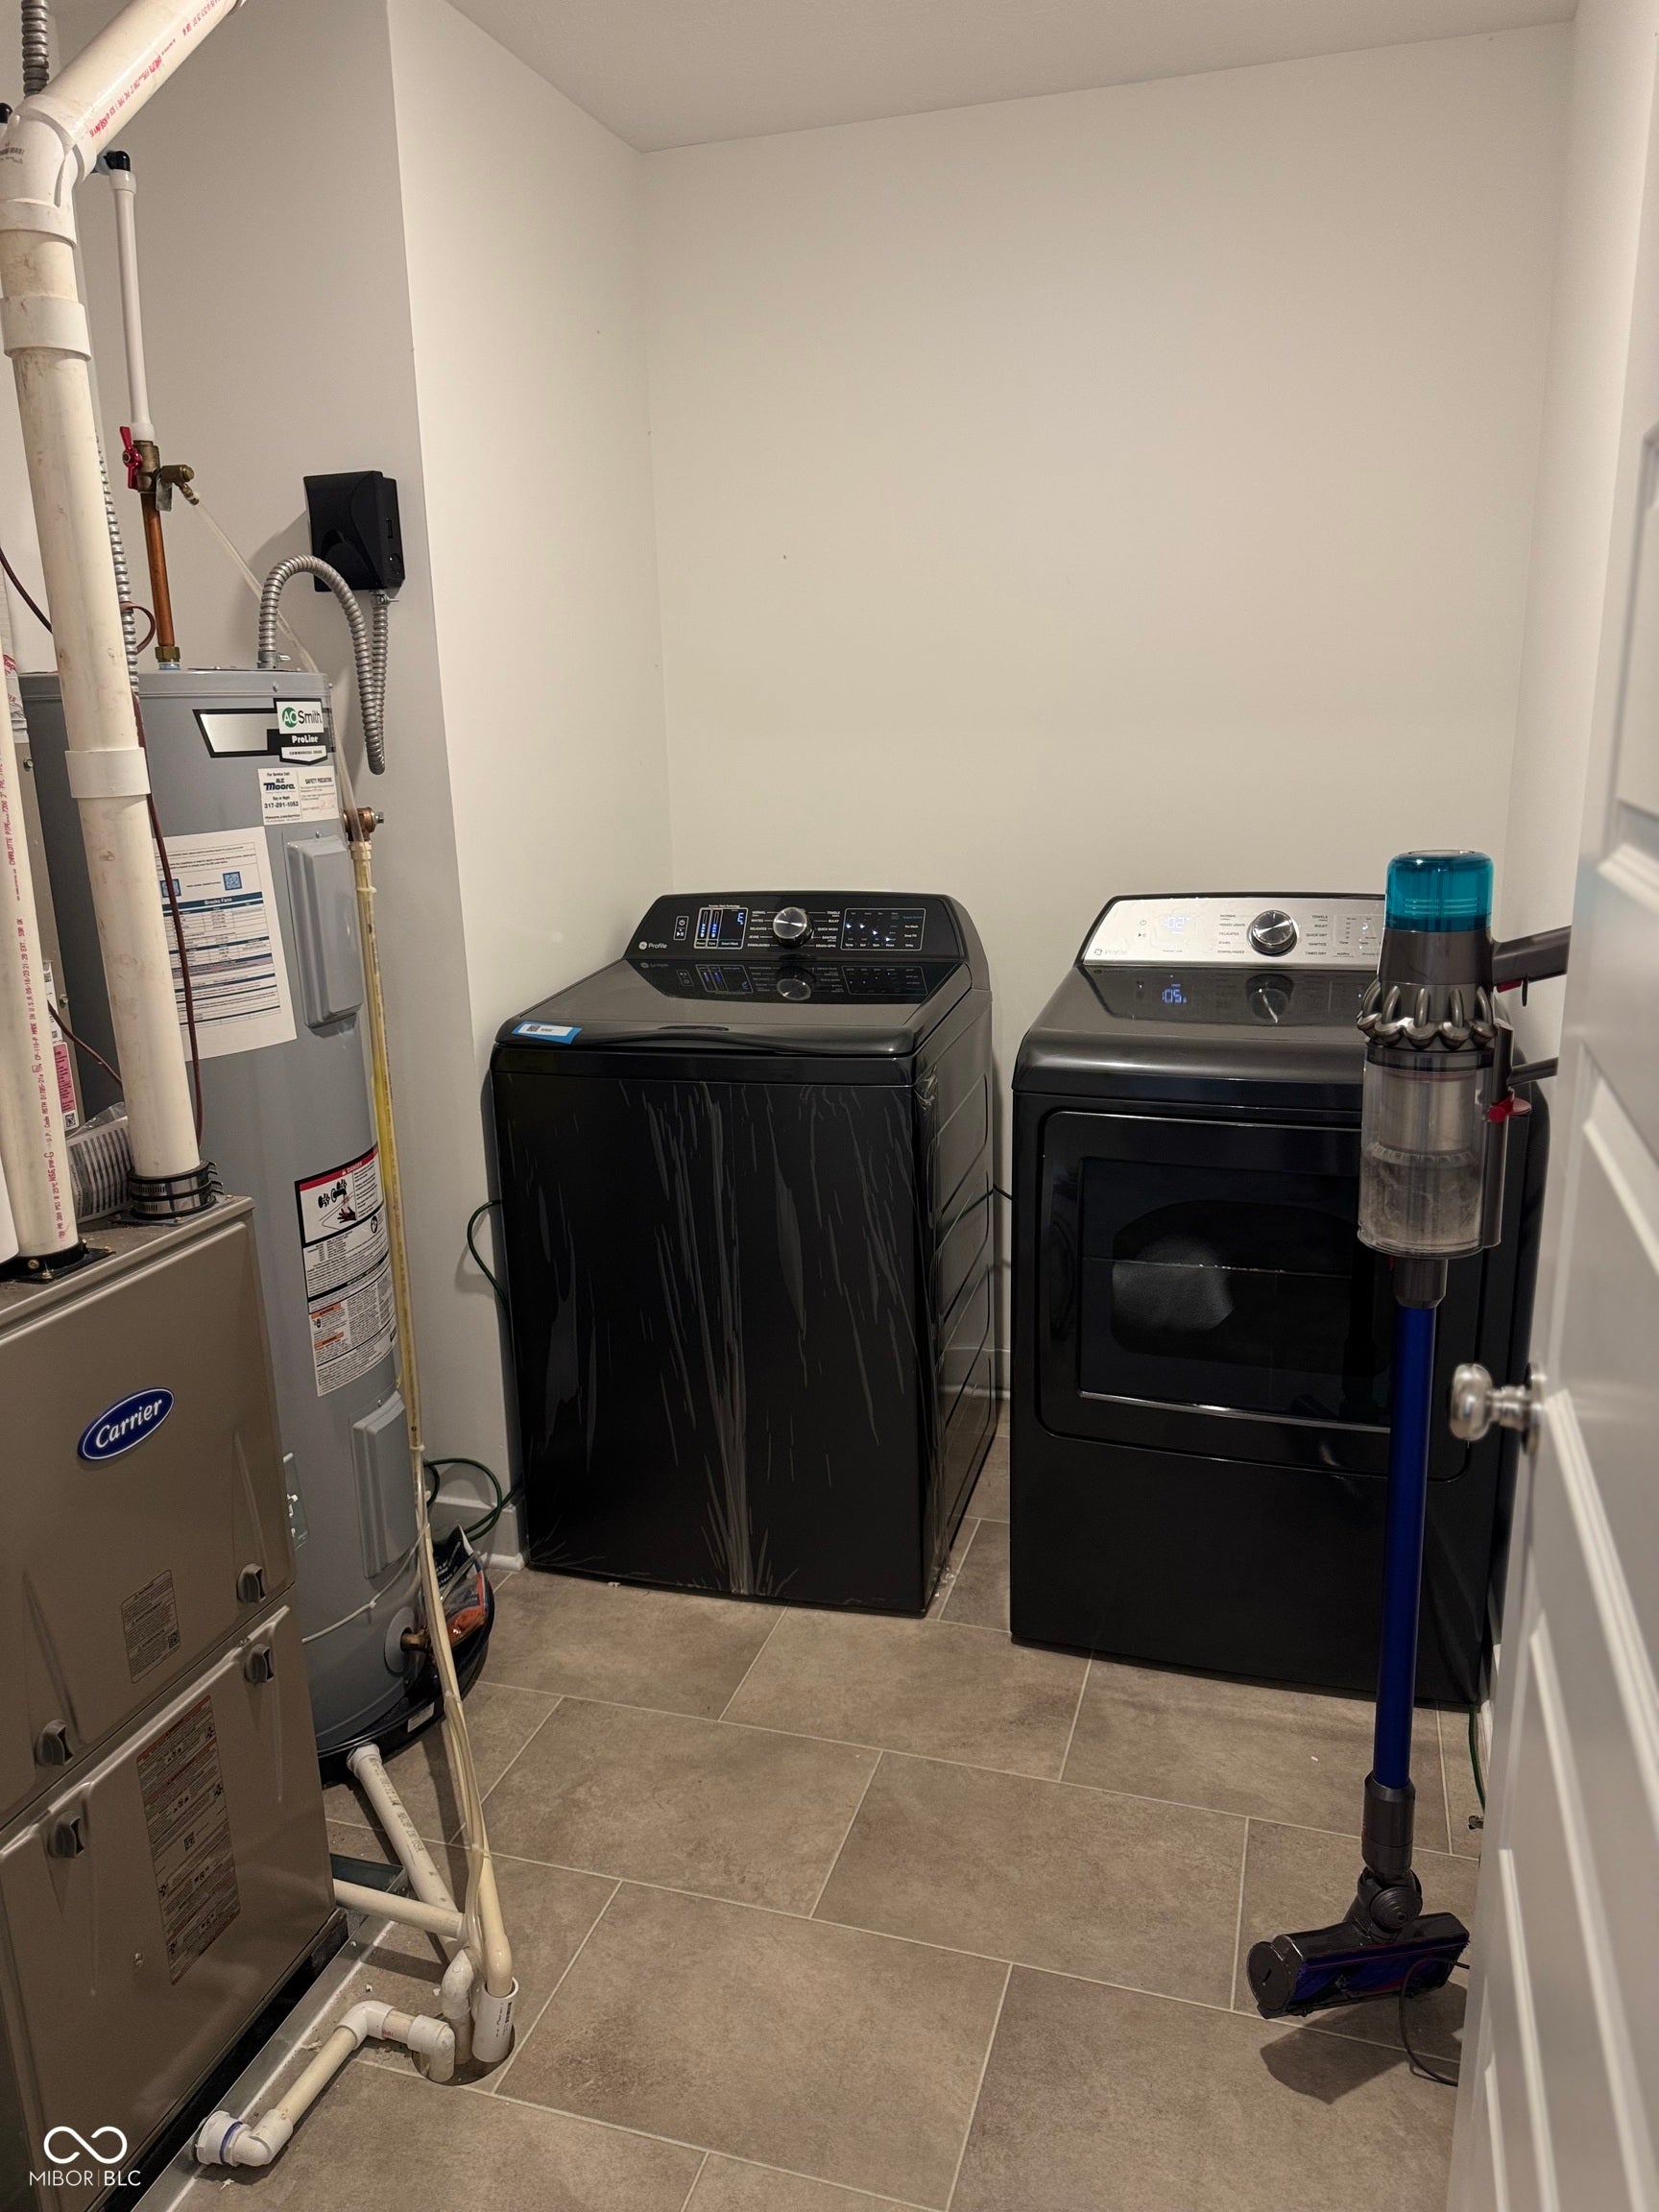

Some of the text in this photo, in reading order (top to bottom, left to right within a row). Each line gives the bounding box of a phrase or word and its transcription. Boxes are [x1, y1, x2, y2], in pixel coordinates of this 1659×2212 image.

[298, 709, 323, 724] Smith
[263, 782, 296, 791] Moore
[95, 1399, 163, 1448] Carrier
